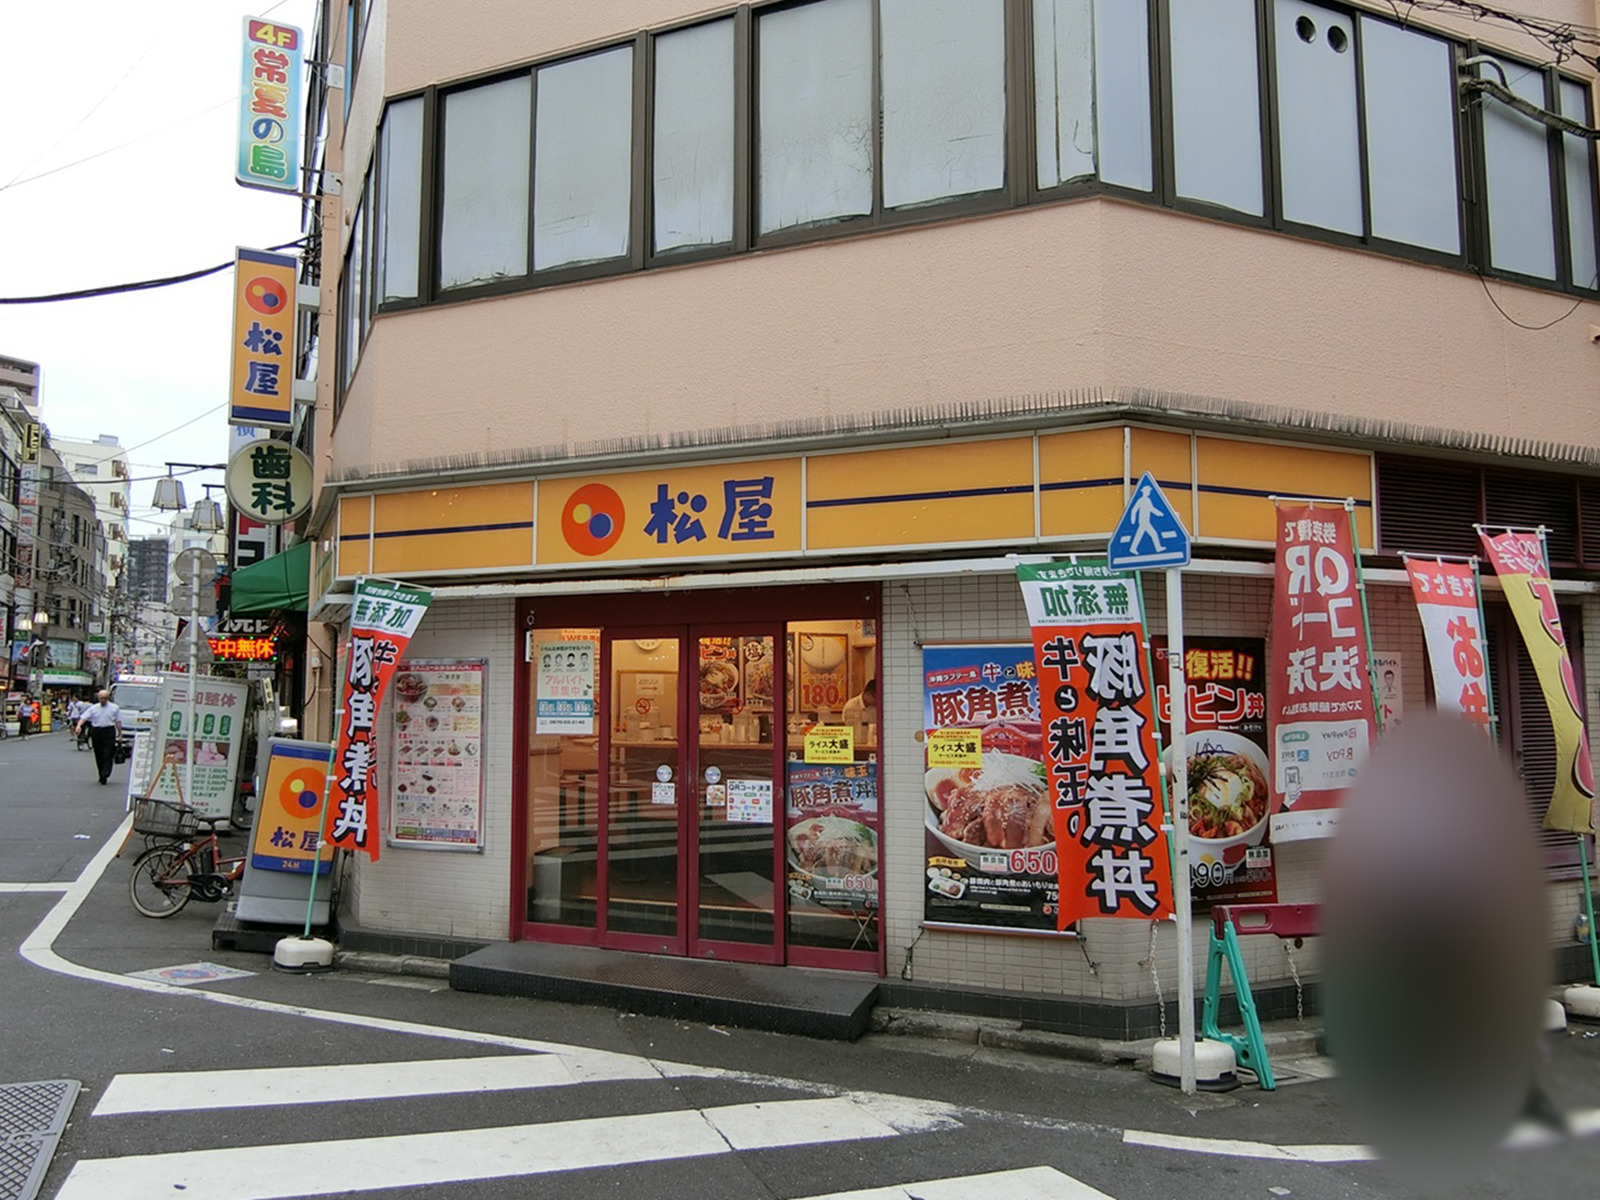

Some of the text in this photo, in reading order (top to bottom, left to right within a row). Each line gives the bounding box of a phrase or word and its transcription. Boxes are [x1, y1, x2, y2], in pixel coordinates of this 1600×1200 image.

[256, 24, 292, 47] 4F
[250, 49, 290, 179] 常夏の島
[243, 321, 284, 396] 松屋
[250, 445, 295, 515] 歯科
[643, 476, 774, 544] 松屋
[356, 598, 414, 628] 無添加
[929, 671, 977, 683] 沖縄ラフテー風
[1185, 649, 1254, 681] 復活!!
[545, 675, 585, 685] アルバイト
[931, 680, 1040, 726] 豚角煮
[333, 636, 374, 846] 豚角煮丼
[809, 739, 849, 749] ライス大盛
[933, 742, 977, 753] ライス大盛
[270, 826, 320, 851] 松屋
[282, 860, 300, 869] 24H
[1010, 850, 1058, 875] 650
